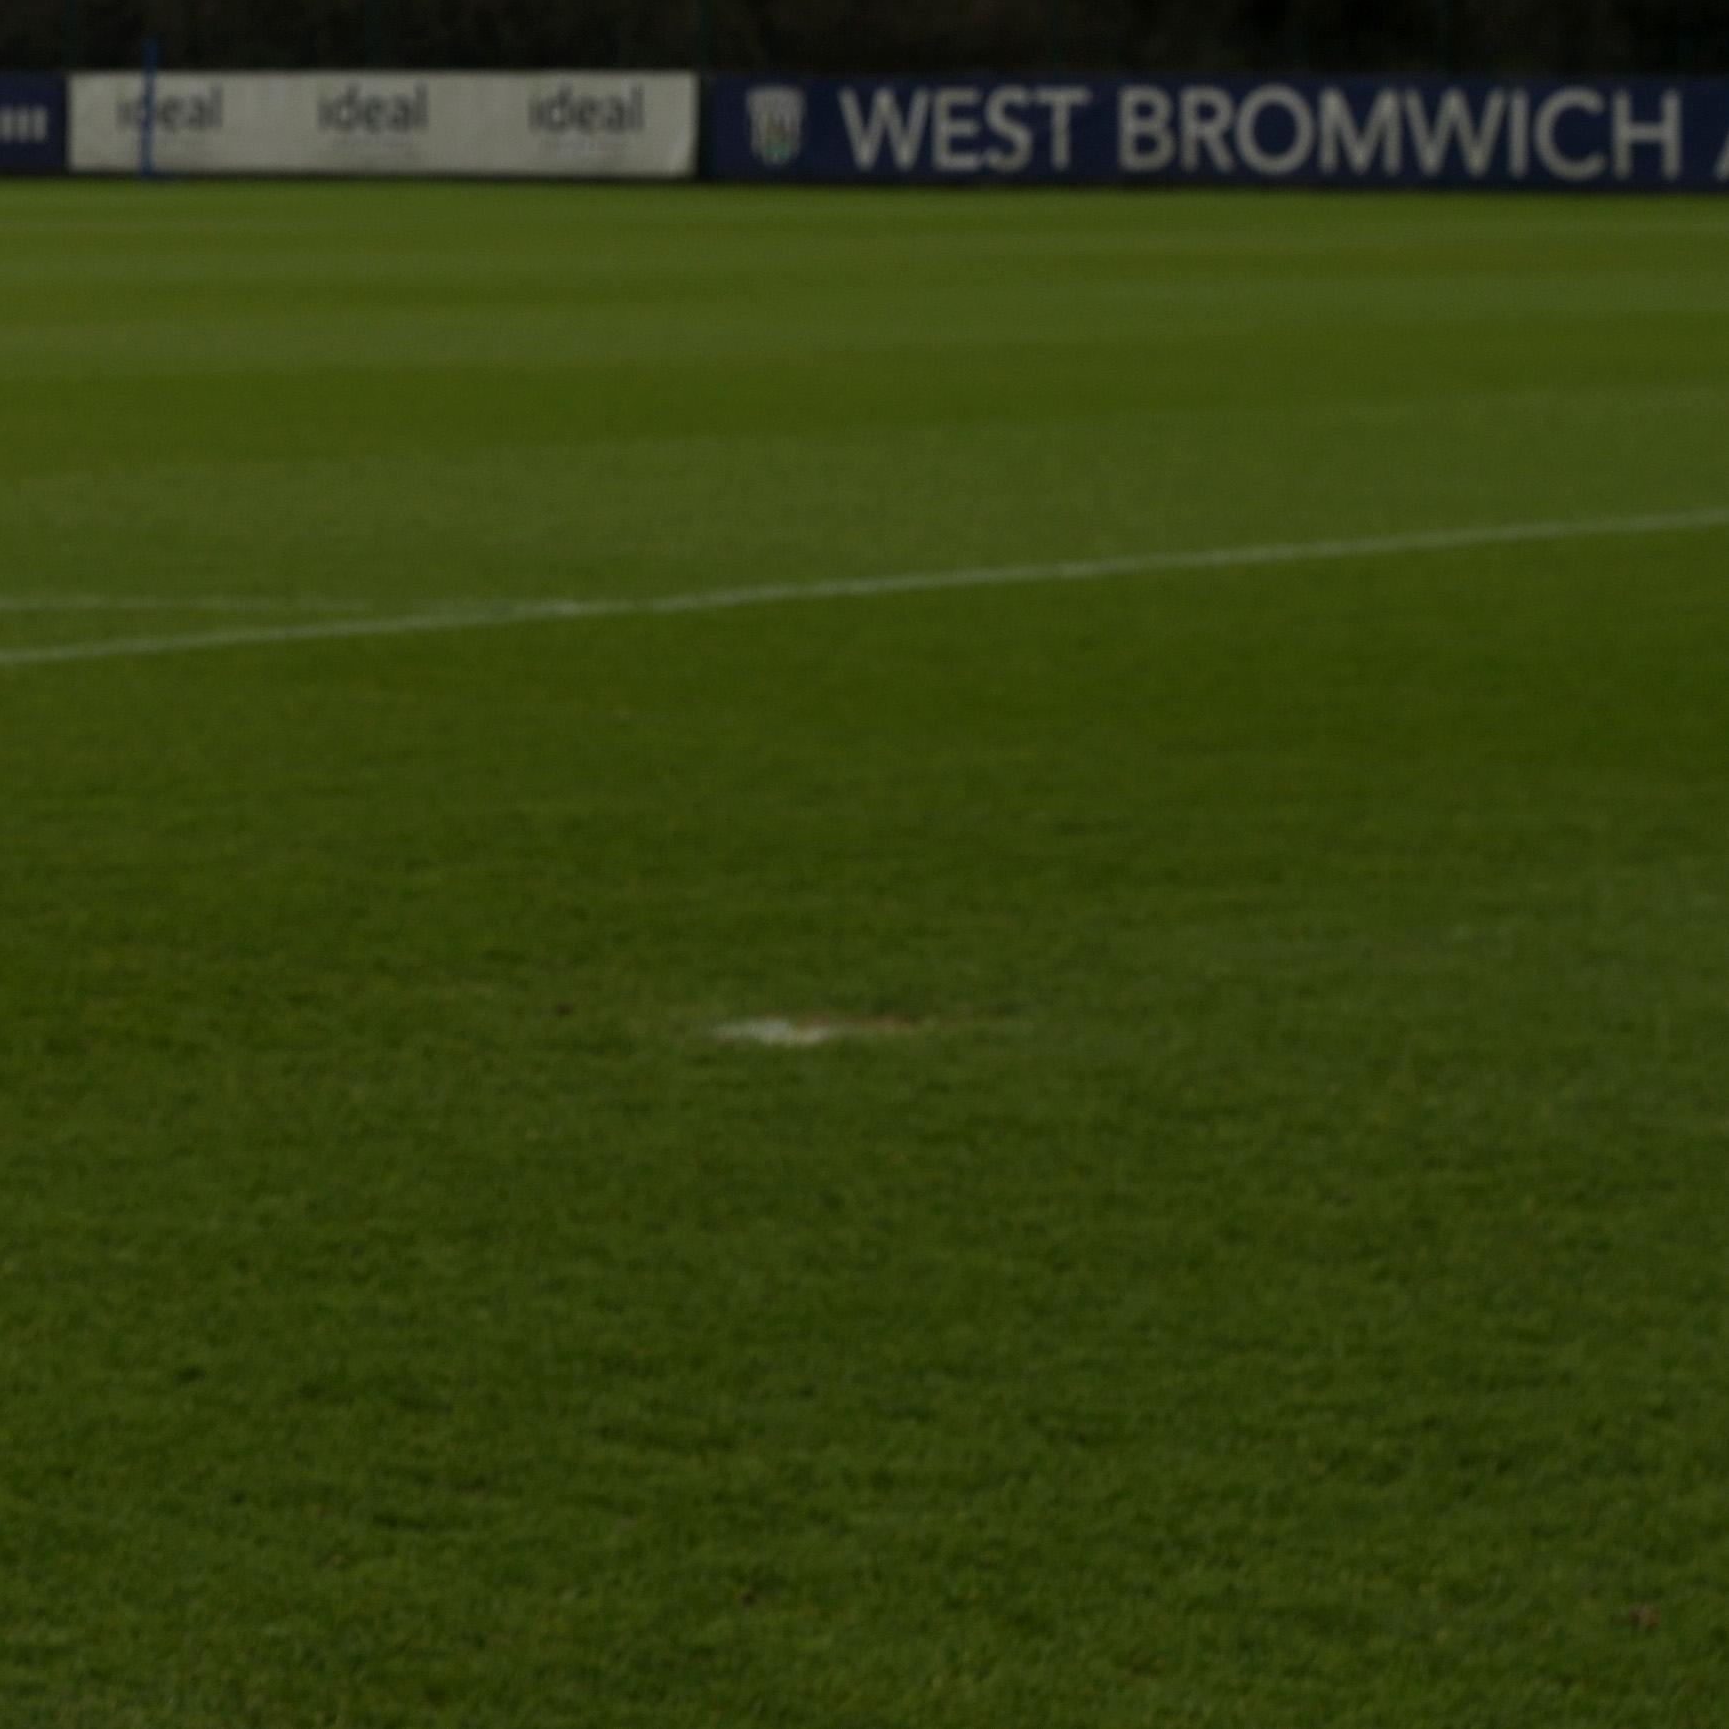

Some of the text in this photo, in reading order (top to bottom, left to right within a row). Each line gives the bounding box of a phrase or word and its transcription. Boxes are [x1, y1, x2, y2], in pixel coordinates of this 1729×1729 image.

[316, 82, 429, 134] ideal
[528, 82, 646, 135] ideal
[839, 84, 1091, 175] WEST
[1117, 83, 1683, 181] BROMWICH
